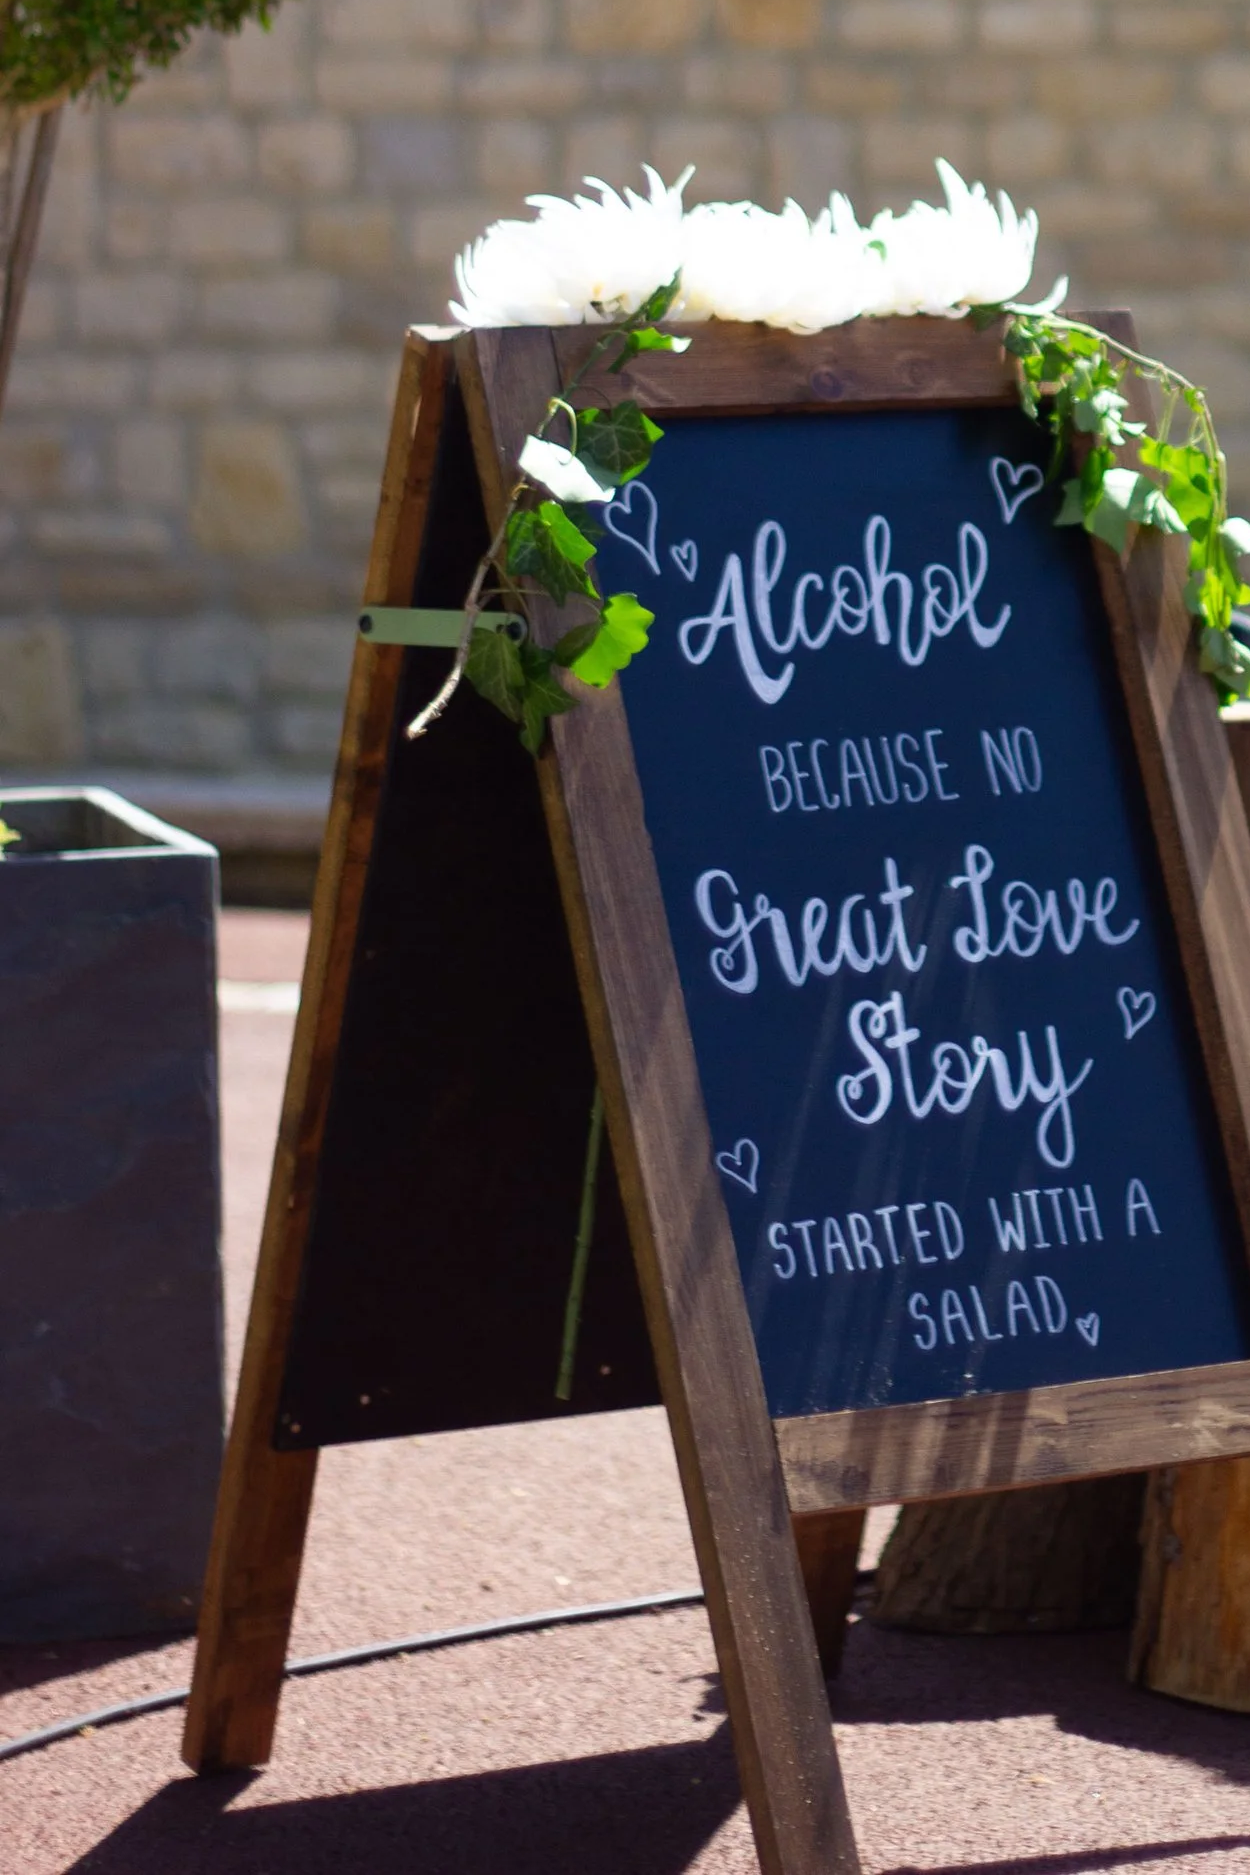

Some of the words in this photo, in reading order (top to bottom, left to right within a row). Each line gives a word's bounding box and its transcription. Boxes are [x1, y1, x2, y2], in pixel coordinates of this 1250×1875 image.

[678, 514, 1012, 705] Alcohol
[760, 729, 960, 813] BECAUSE
[980, 726, 1042, 797] NO
[694, 856, 929, 994] Great
[949, 843, 1141, 964] Love
[835, 989, 1095, 1170] Story
[767, 1201, 966, 1280] STARTED
[988, 1184, 1104, 1253] WITH
[1126, 1177, 1162, 1238] A
[907, 1274, 1068, 1351] SALAD
